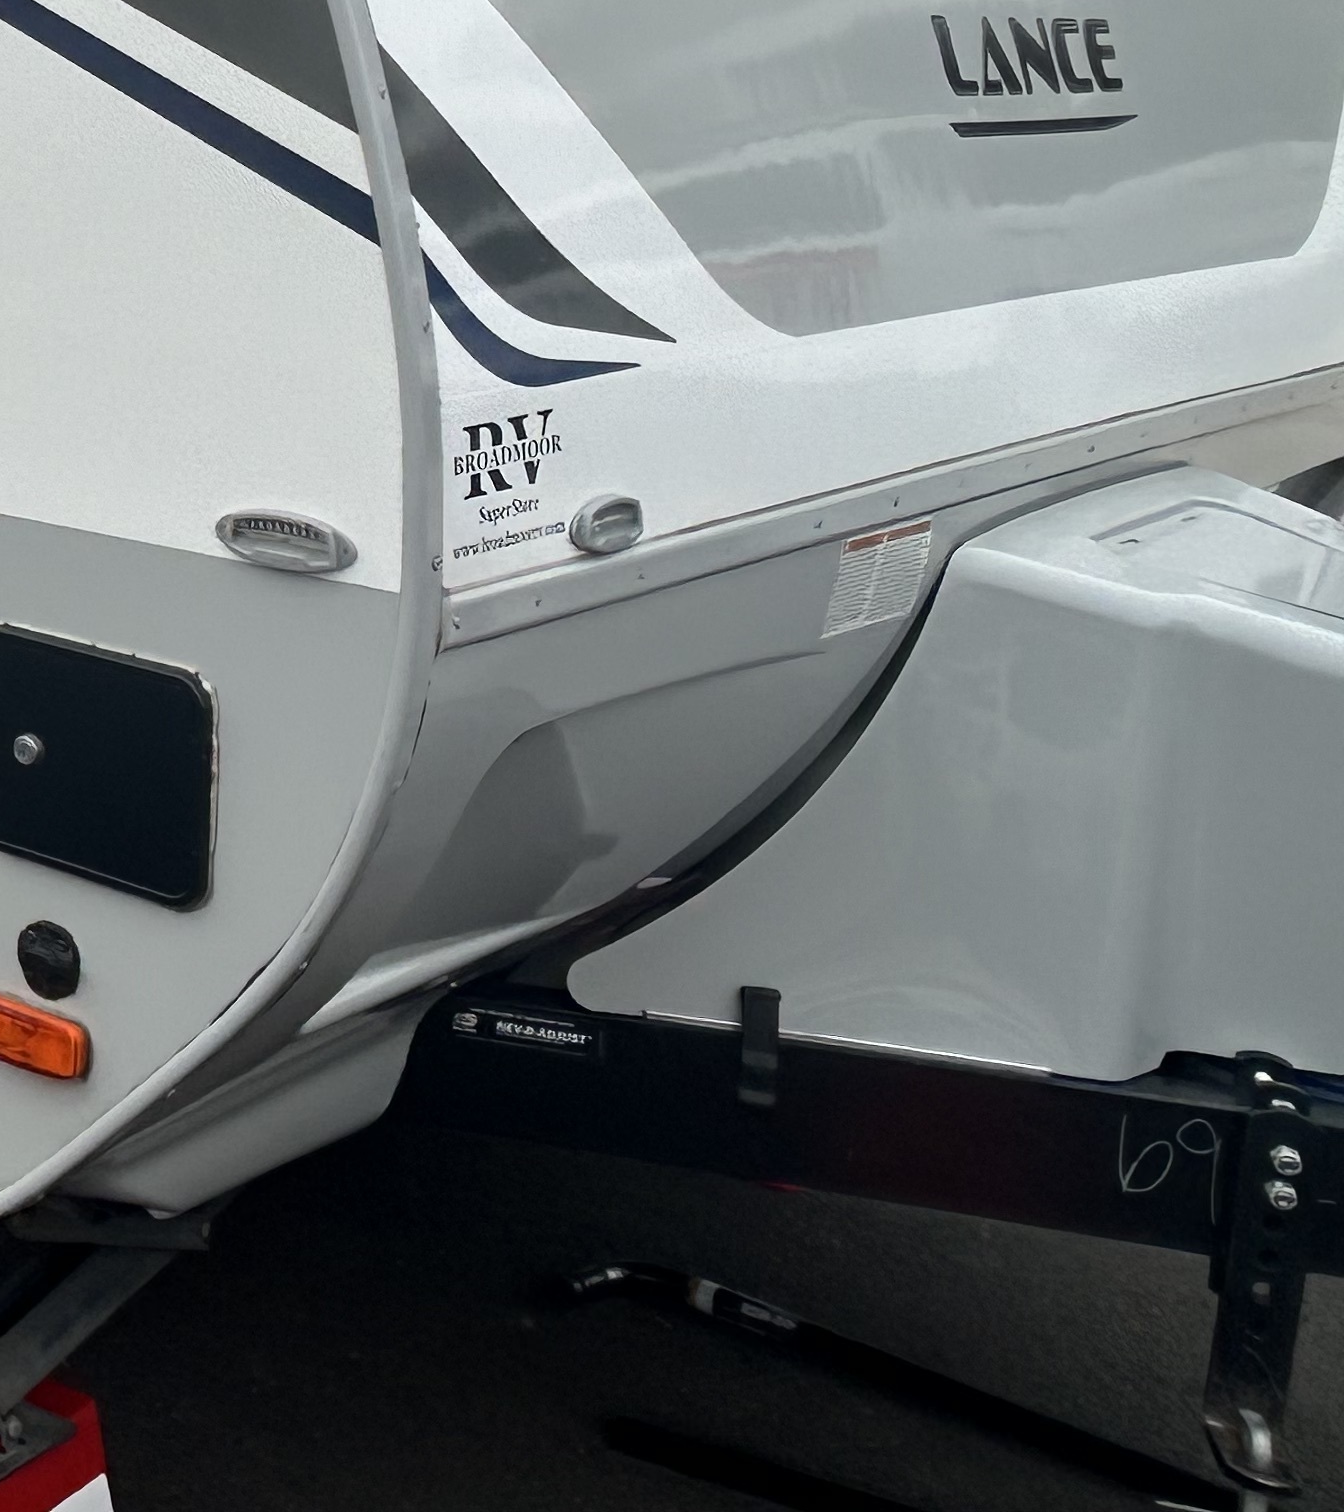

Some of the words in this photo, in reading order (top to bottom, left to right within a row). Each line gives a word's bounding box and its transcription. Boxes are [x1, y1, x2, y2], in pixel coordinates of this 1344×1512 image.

[930, 14, 1124, 96] LANCE
[454, 435, 562, 476] BROADMOOR
[463, 409, 553, 500] RV
